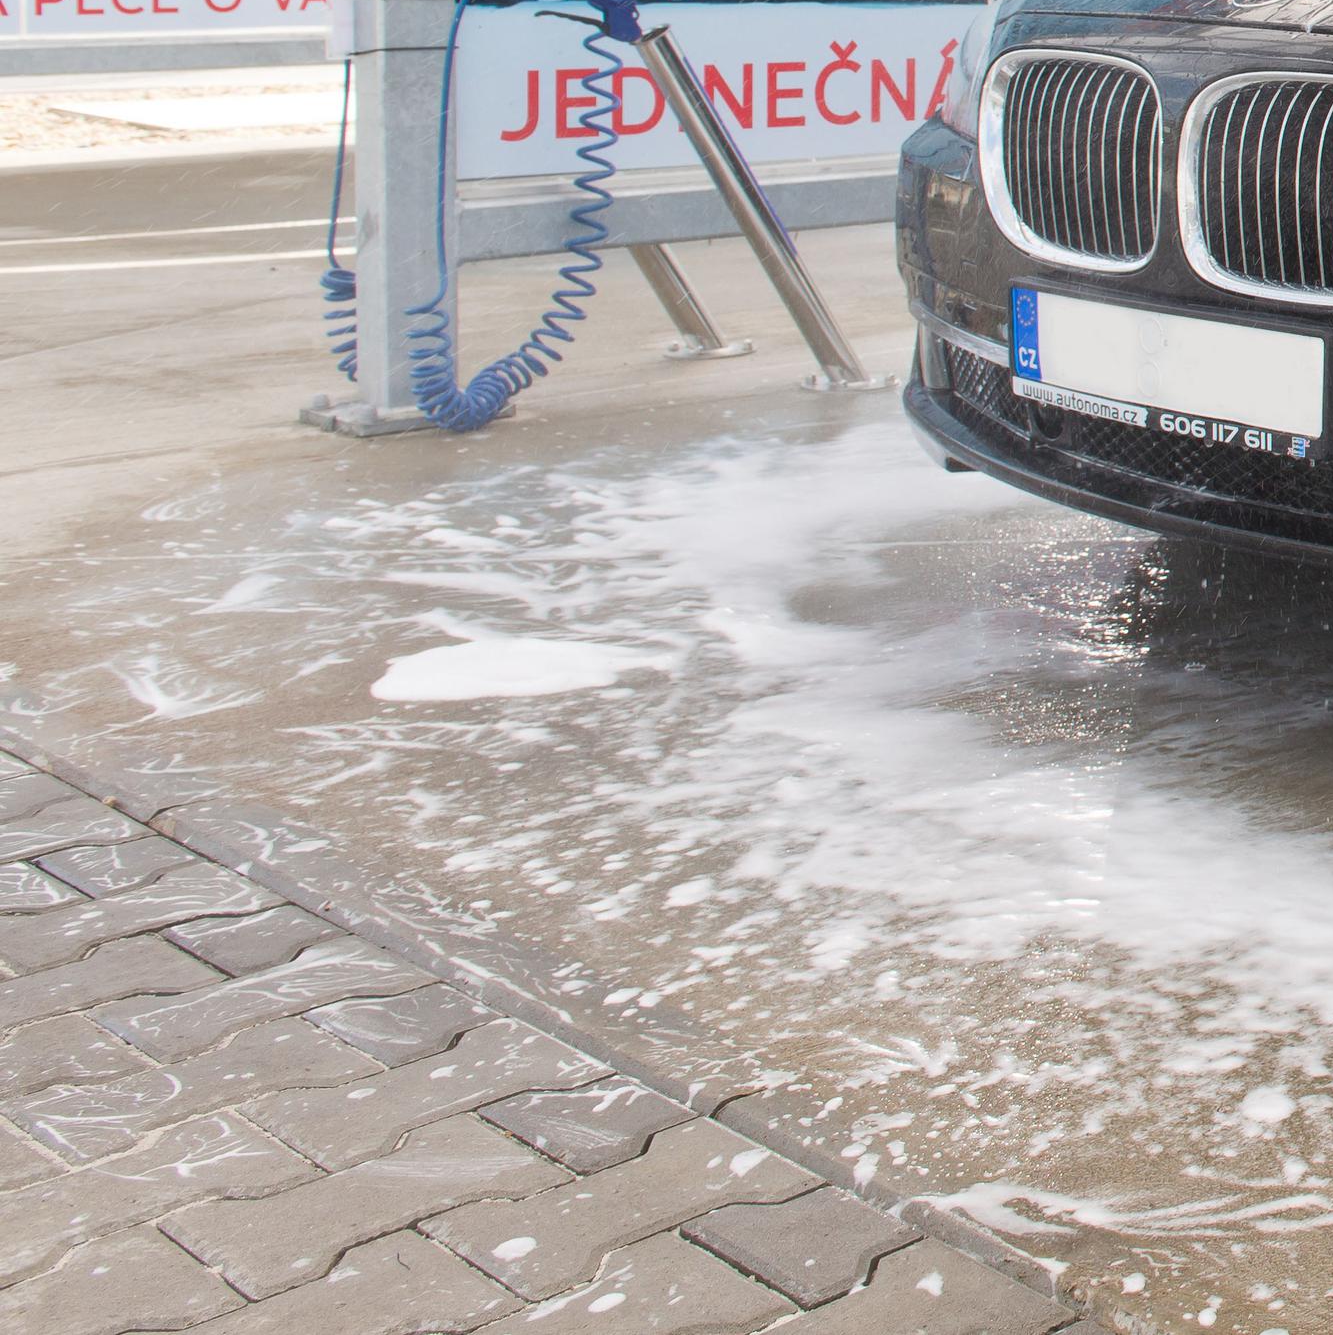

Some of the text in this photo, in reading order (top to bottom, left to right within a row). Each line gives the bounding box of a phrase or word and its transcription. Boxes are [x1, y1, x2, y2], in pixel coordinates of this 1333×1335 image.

[500, 37, 958, 142] JEDNEČNÁ
[1018, 346, 1039, 370] CZ
[1022, 382, 1138, 424] www.autonoma.cz
[1159, 413, 1206, 438] 606
[1212, 422, 1239, 444] 117
[1244, 429, 1273, 452] 611
